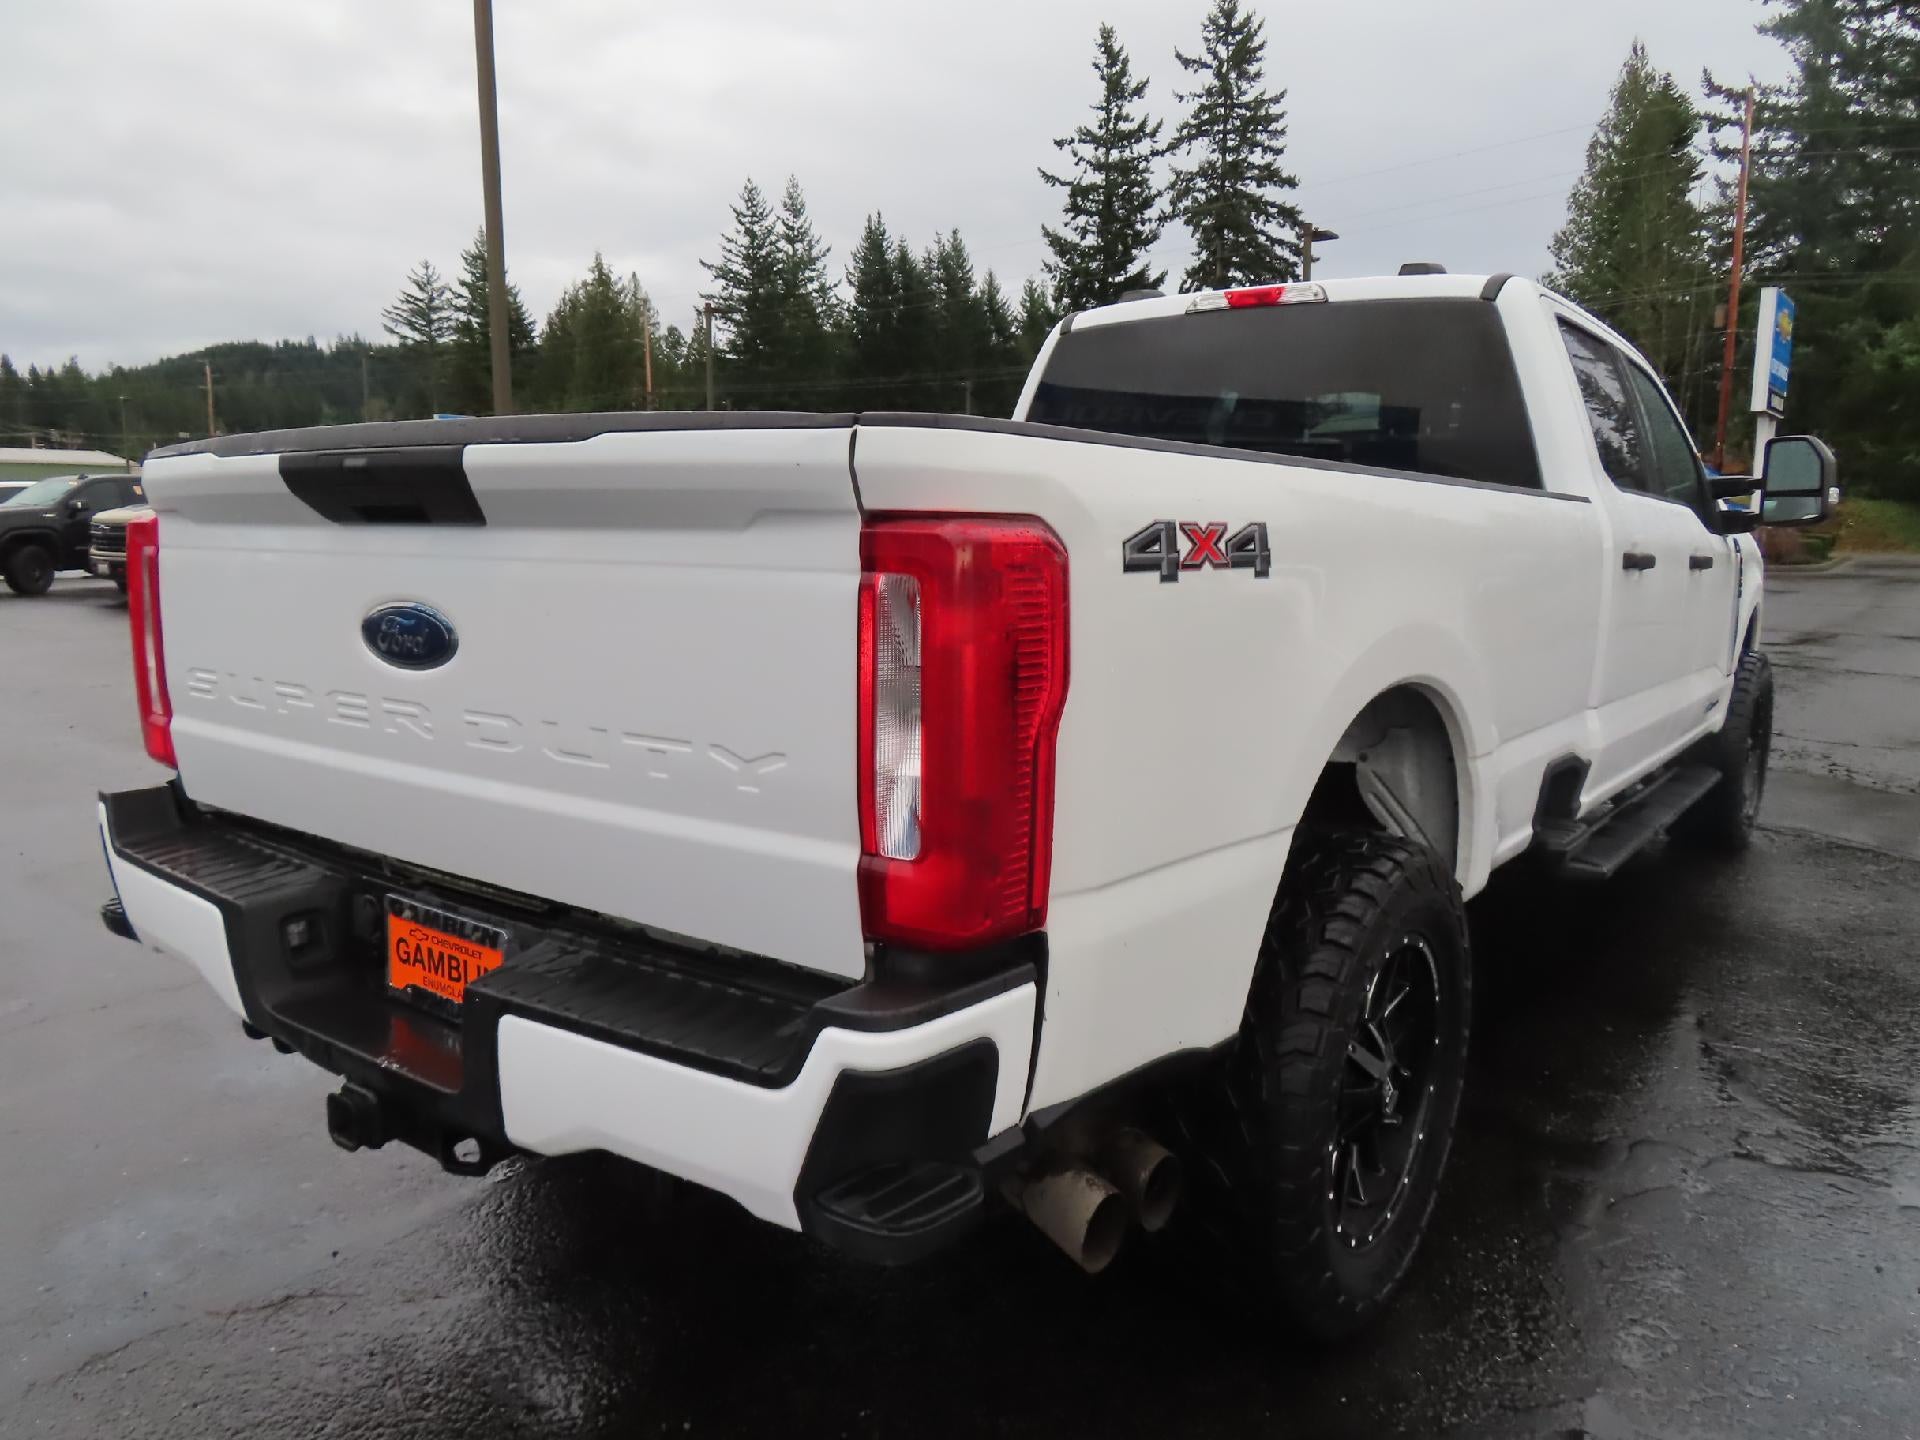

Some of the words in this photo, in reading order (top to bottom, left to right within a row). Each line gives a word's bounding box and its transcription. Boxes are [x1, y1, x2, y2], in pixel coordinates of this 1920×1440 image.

[377, 615, 431, 655] Ford
[187, 667, 434, 740] SUPER
[463, 708, 788, 793] DUTY
[395, 936, 490, 984] GAMBLI
[431, 934, 484, 961] CHEVROLET
